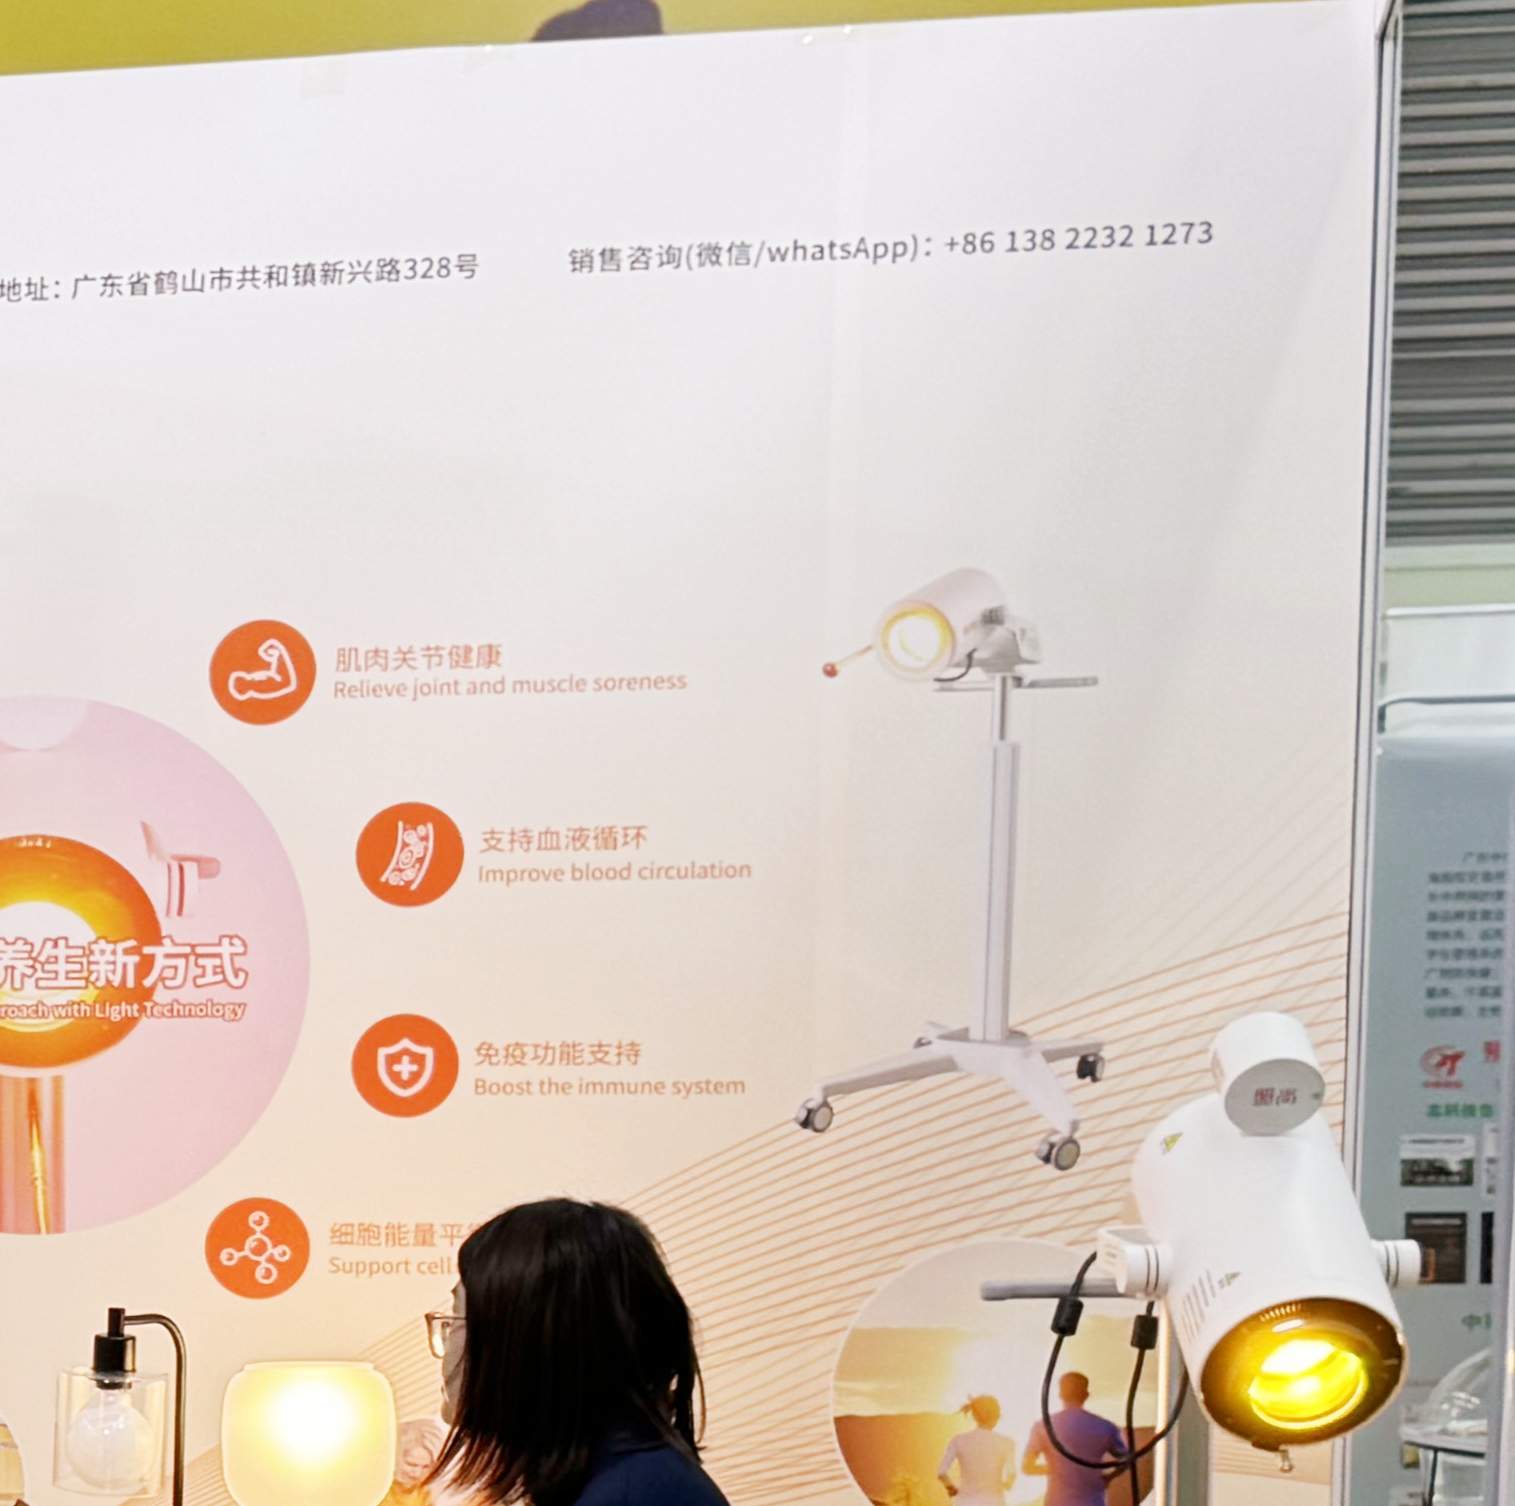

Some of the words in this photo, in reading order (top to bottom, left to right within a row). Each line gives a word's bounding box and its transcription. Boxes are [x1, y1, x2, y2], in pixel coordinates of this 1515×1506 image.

[1005, 229, 1055, 253] 138
[1065, 225, 1134, 250] 2232
[1144, 221, 1213, 246] 1273
[334, 643, 503, 672] 肌肉关节健康
[333, 676, 407, 700] Relieve
[411, 675, 459, 703] joint
[465, 675, 505, 697] and
[511, 673, 587, 695] muscle
[593, 671, 688, 692] soreness
[479, 825, 649, 854] 支持血液循环
[479, 862, 566, 890] Improve
[572, 859, 633, 883] blood
[639, 857, 752, 881] circulation
[54, 1001, 90, 1018] with
[95, 1001, 139, 1021] Light
[144, 1001, 247, 1022] Technology
[473, 1040, 642, 1070] 免疫功能支持
[474, 1076, 530, 1098] Boost
[536, 1076, 568, 1097] the
[574, 1075, 666, 1097] immune
[672, 1076, 746, 1102] system
[329, 1222, 481, 1248] 细胞能量平
[329, 1256, 411, 1279] Support
